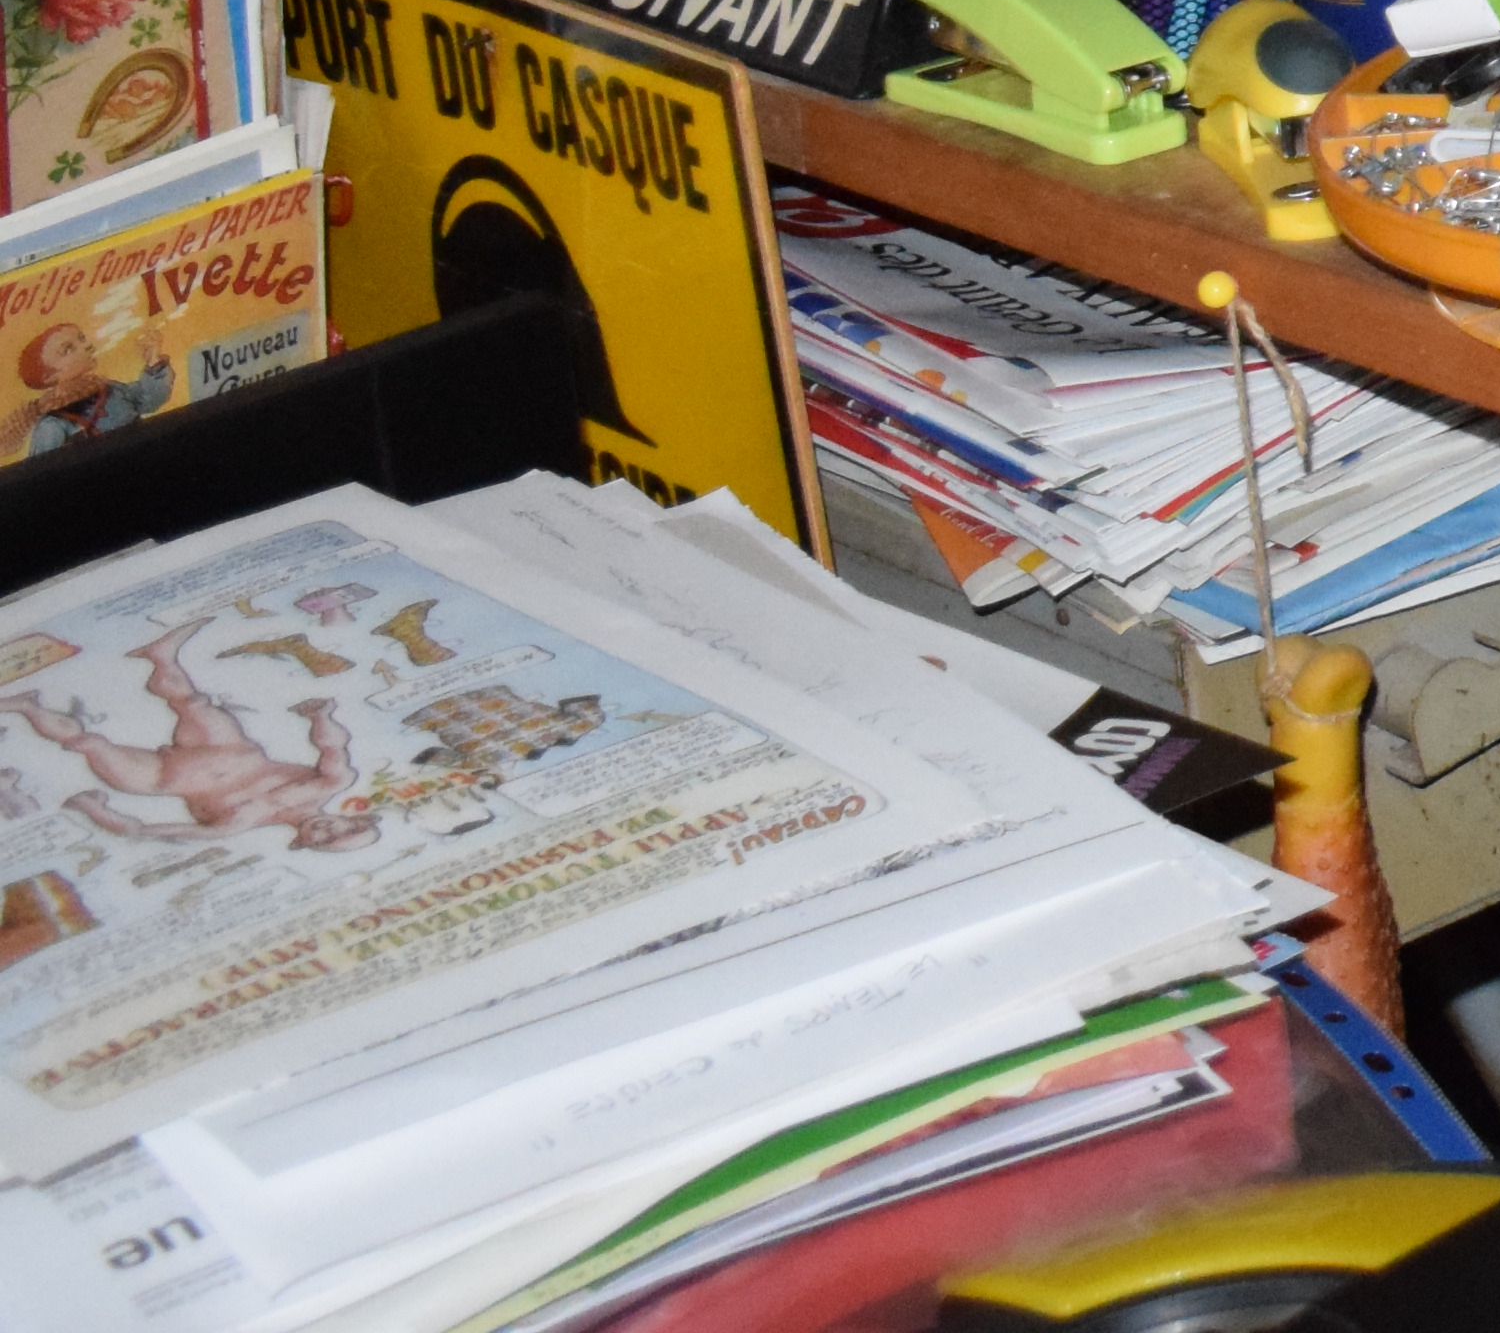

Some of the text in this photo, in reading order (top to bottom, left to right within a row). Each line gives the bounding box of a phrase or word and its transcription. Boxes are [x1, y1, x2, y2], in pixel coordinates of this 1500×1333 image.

[424, 12, 497, 131] DU
[515, 41, 710, 217] CASQUE
[86, 237, 165, 295] fume
[200, 185, 310, 253] PAPIER
[140, 239, 316, 318] Ivette
[200, 322, 300, 386] Nouveau
